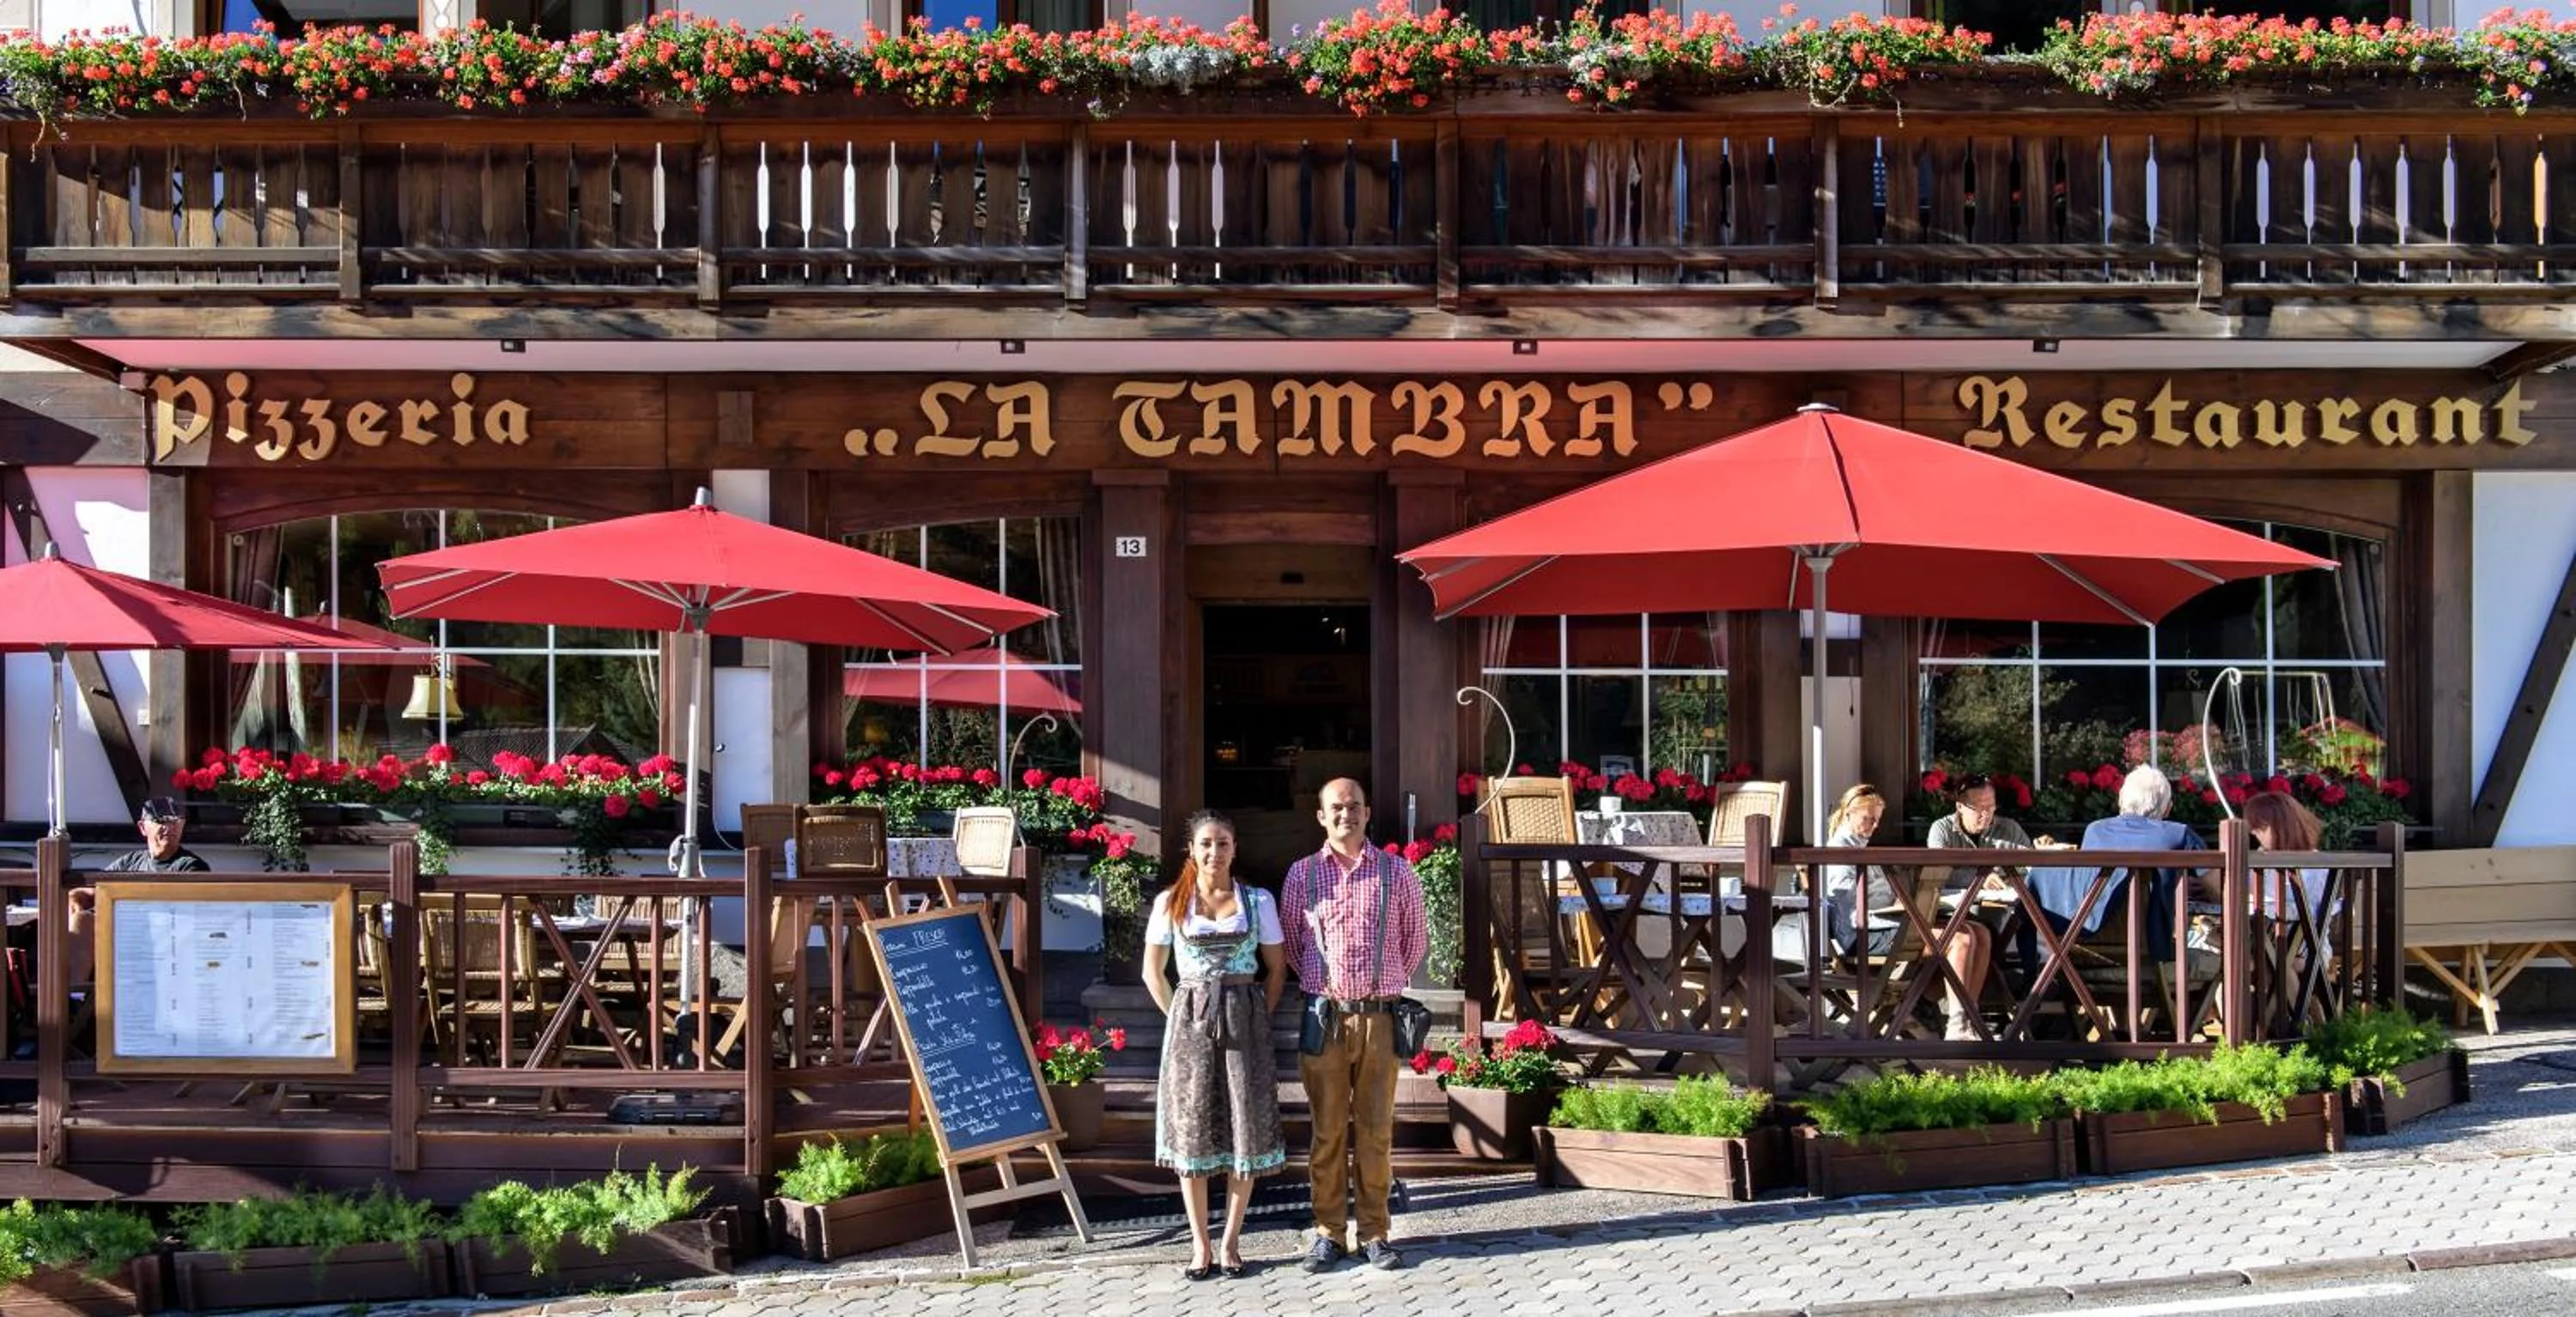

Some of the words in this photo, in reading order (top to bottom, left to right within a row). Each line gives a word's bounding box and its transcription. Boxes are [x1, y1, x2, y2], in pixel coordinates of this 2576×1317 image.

[149, 372, 530, 462] Pizzeria
[1957, 375, 2538, 450] Restaurant
[1121, 539, 1140, 555] 13
